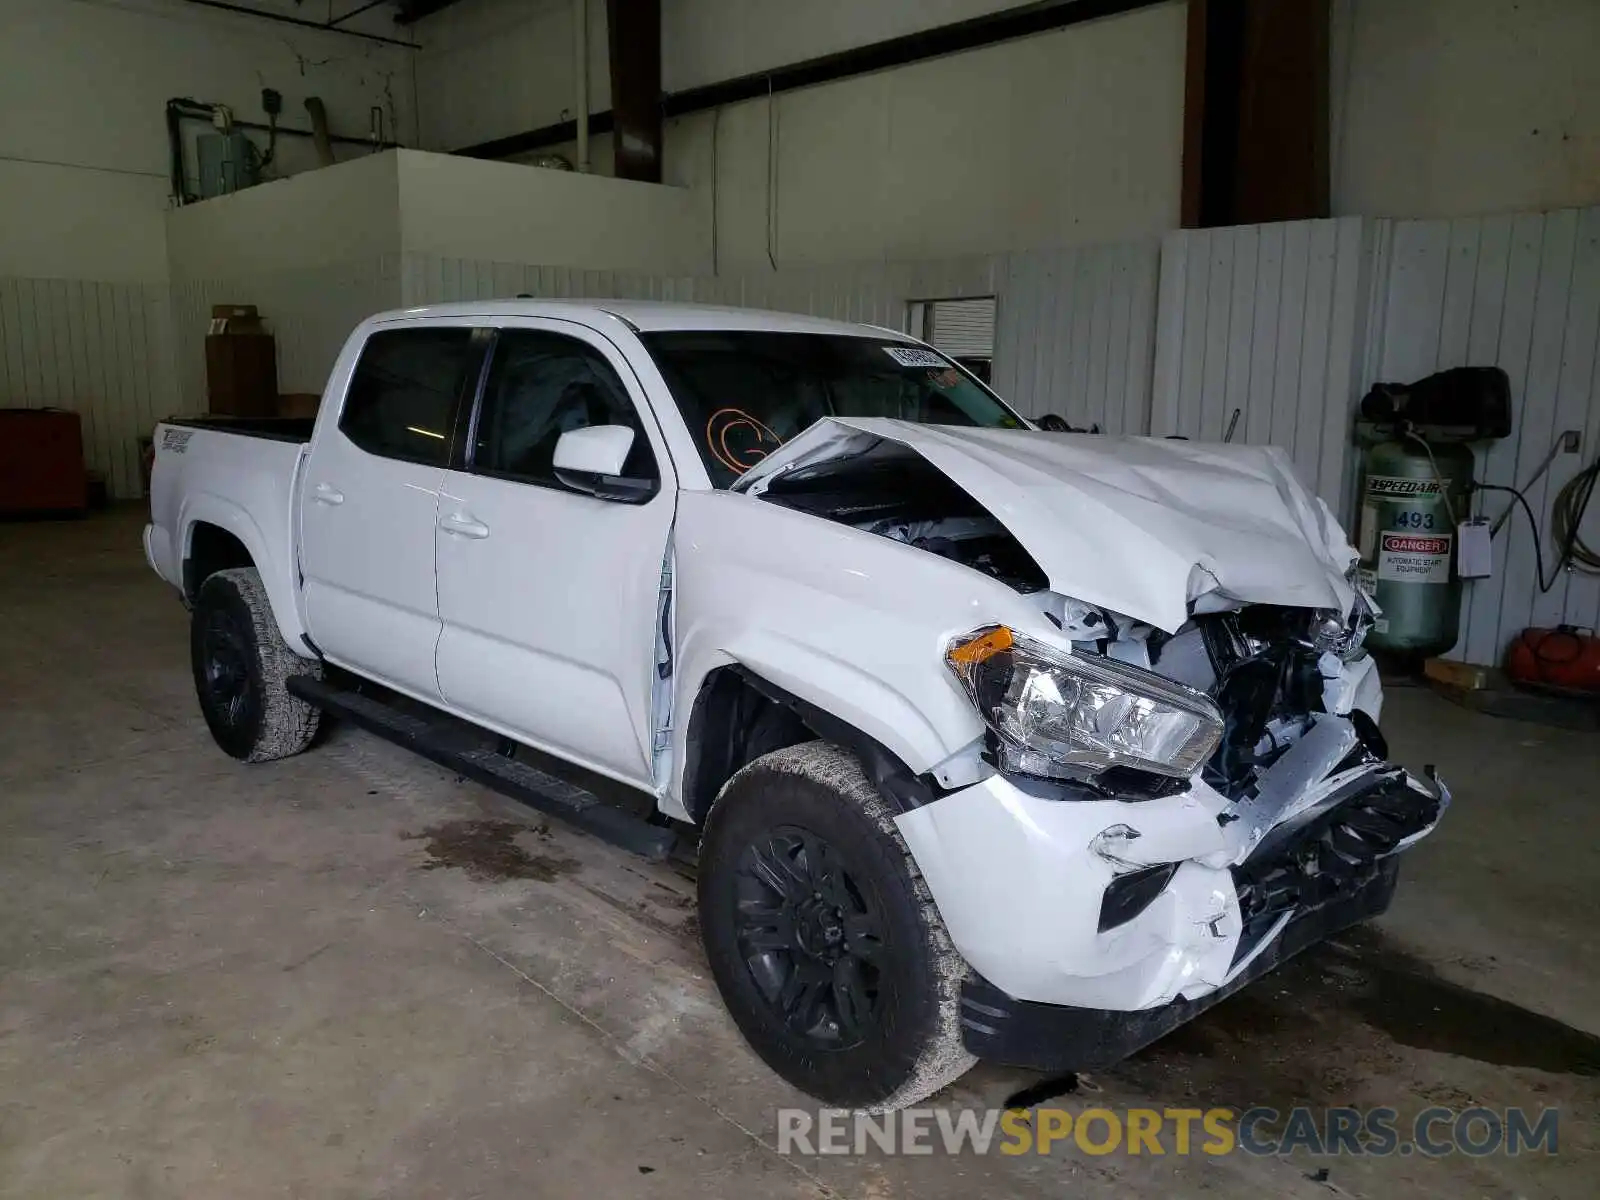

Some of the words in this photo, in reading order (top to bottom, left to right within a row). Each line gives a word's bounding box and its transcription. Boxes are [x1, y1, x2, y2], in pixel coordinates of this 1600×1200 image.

[1391, 538, 1441, 551] DANGER
[1387, 557, 1421, 566] AUTOMATIC
[1423, 559, 1442, 567] START
[1396, 565, 1432, 574] EQUIPMENT
